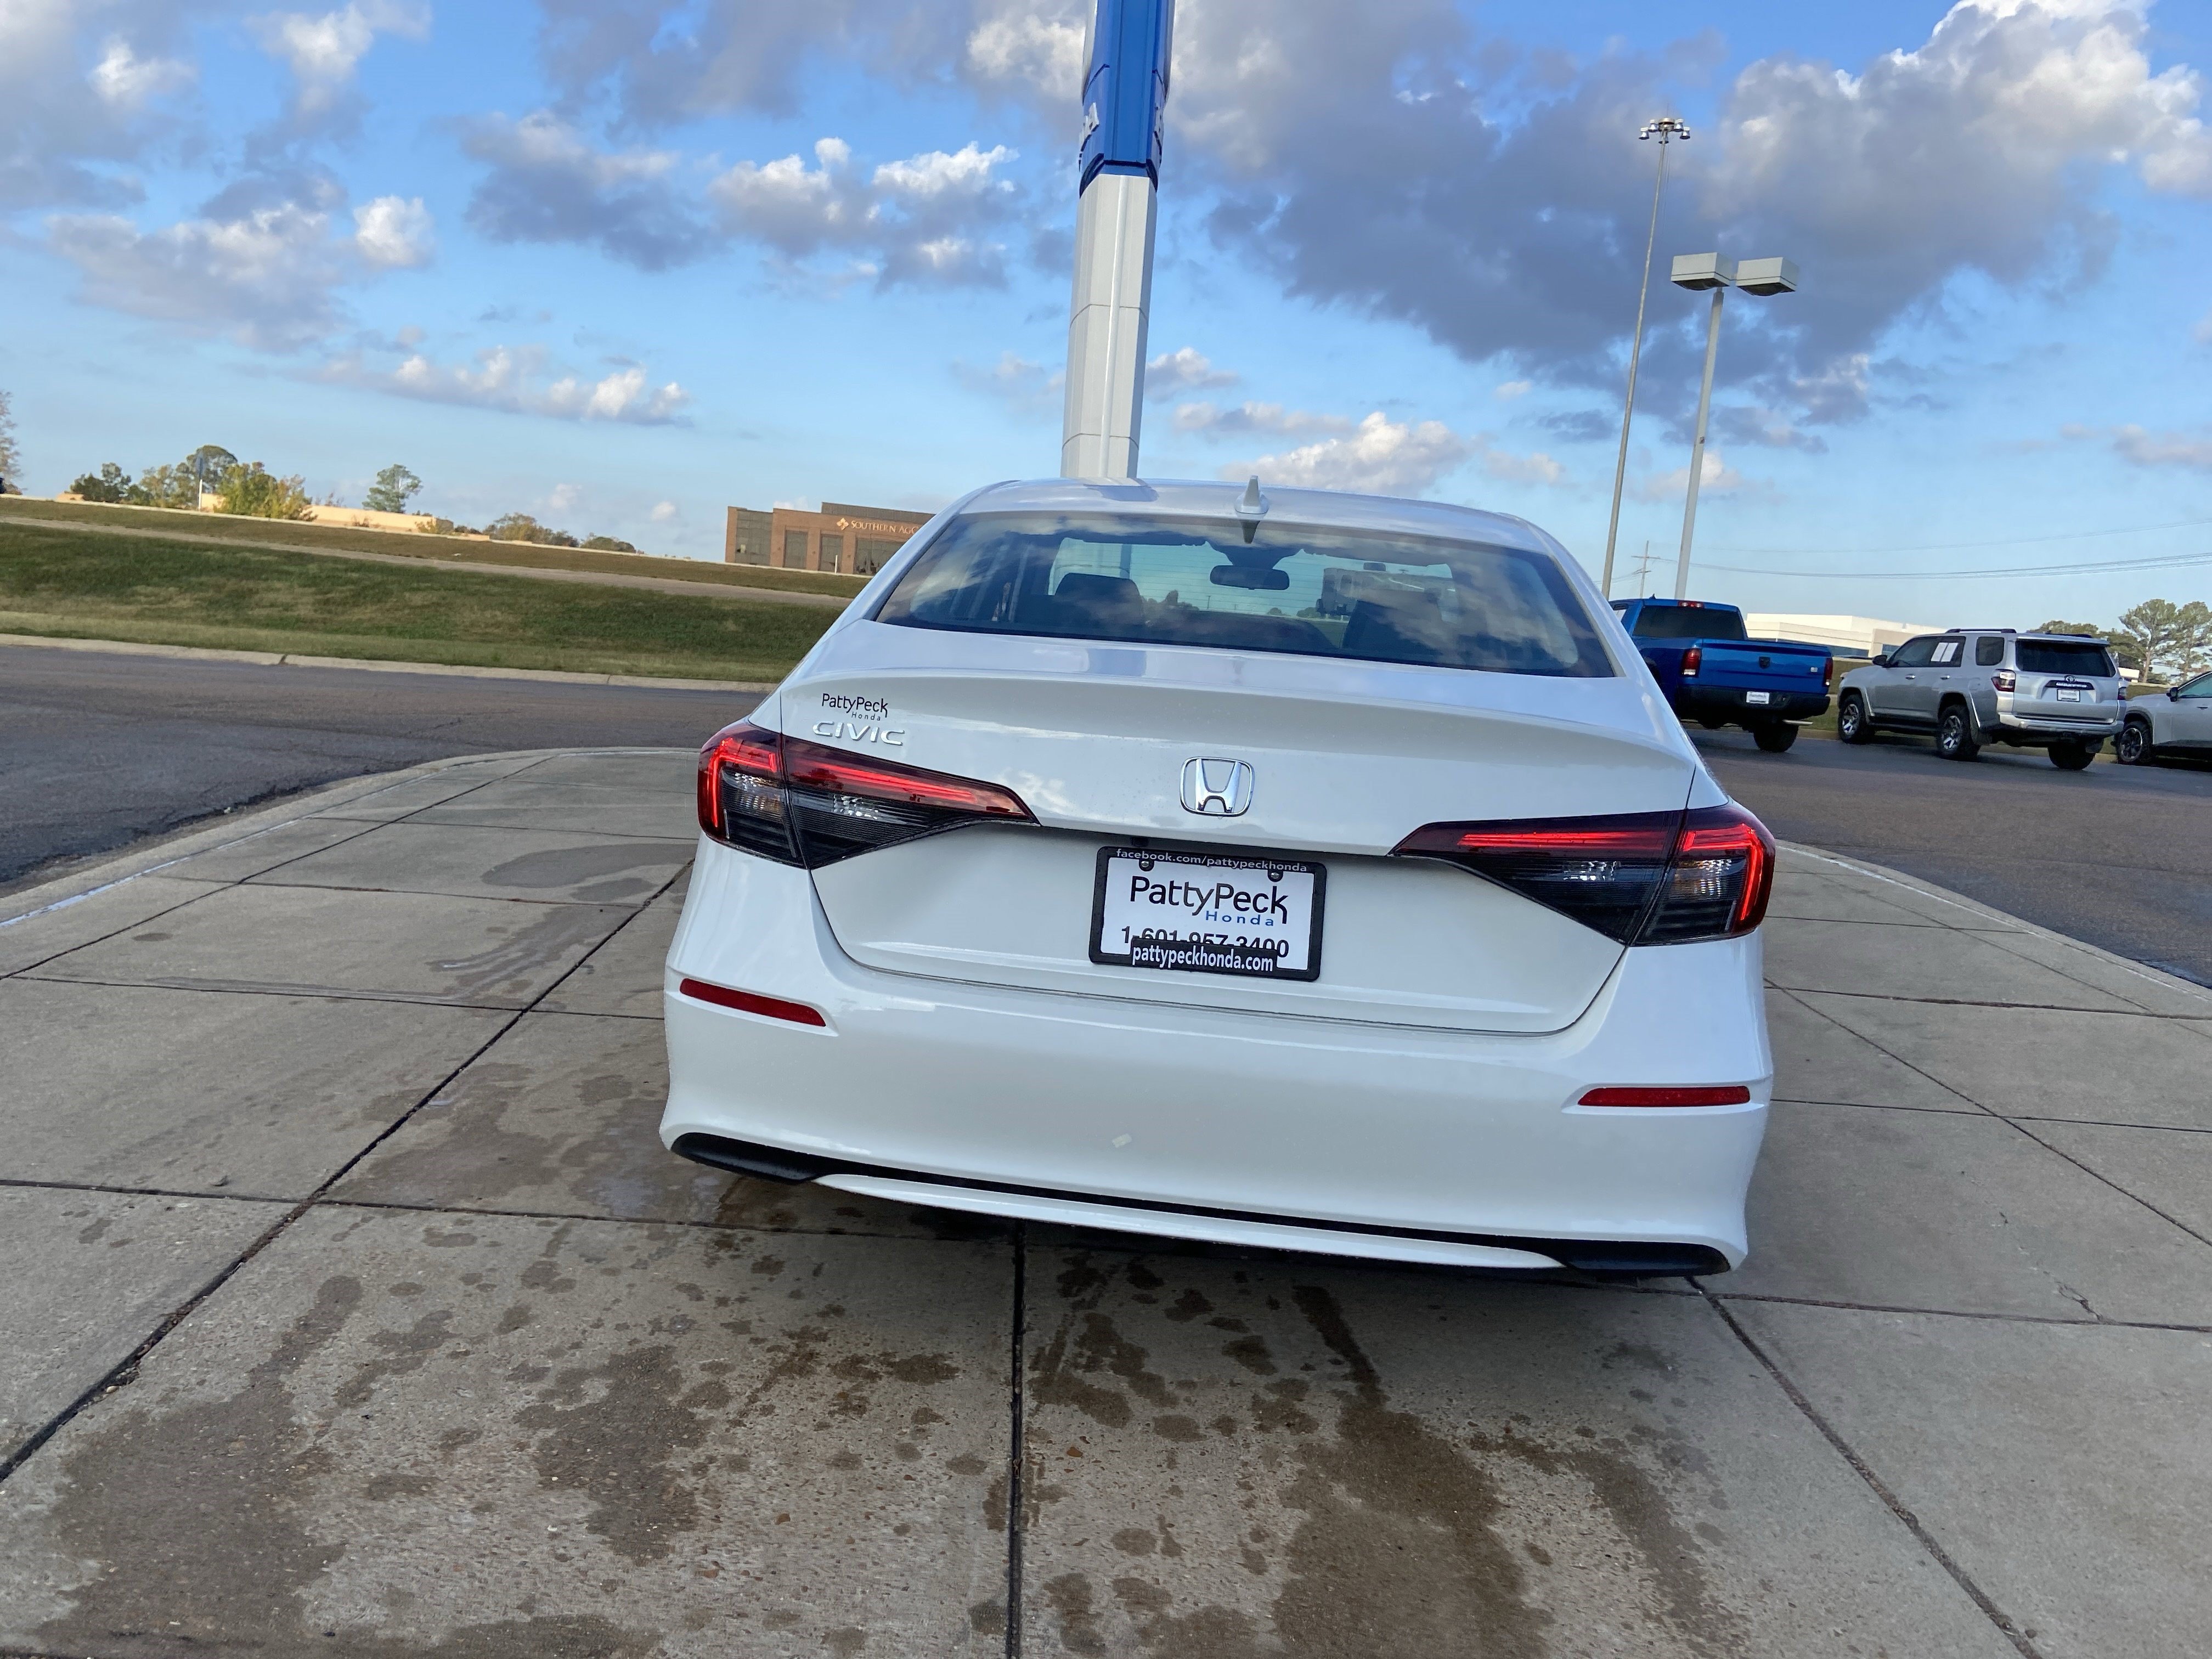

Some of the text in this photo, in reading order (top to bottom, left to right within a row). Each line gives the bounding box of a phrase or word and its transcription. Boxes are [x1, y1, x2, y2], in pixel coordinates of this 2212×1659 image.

[851, 520, 896, 533] SOUTHERN
[822, 693, 888, 718] PattyPeck
[851, 712, 881, 721] Honda
[812, 721, 905, 746] CIVIC
[1116, 848, 1307, 872] facebook.com/pattypeckhonda
[1130, 876, 1289, 924] PattyPeck
[1205, 910, 1274, 927] Honda
[1132, 945, 1273, 972] pattypeckhonda.com
